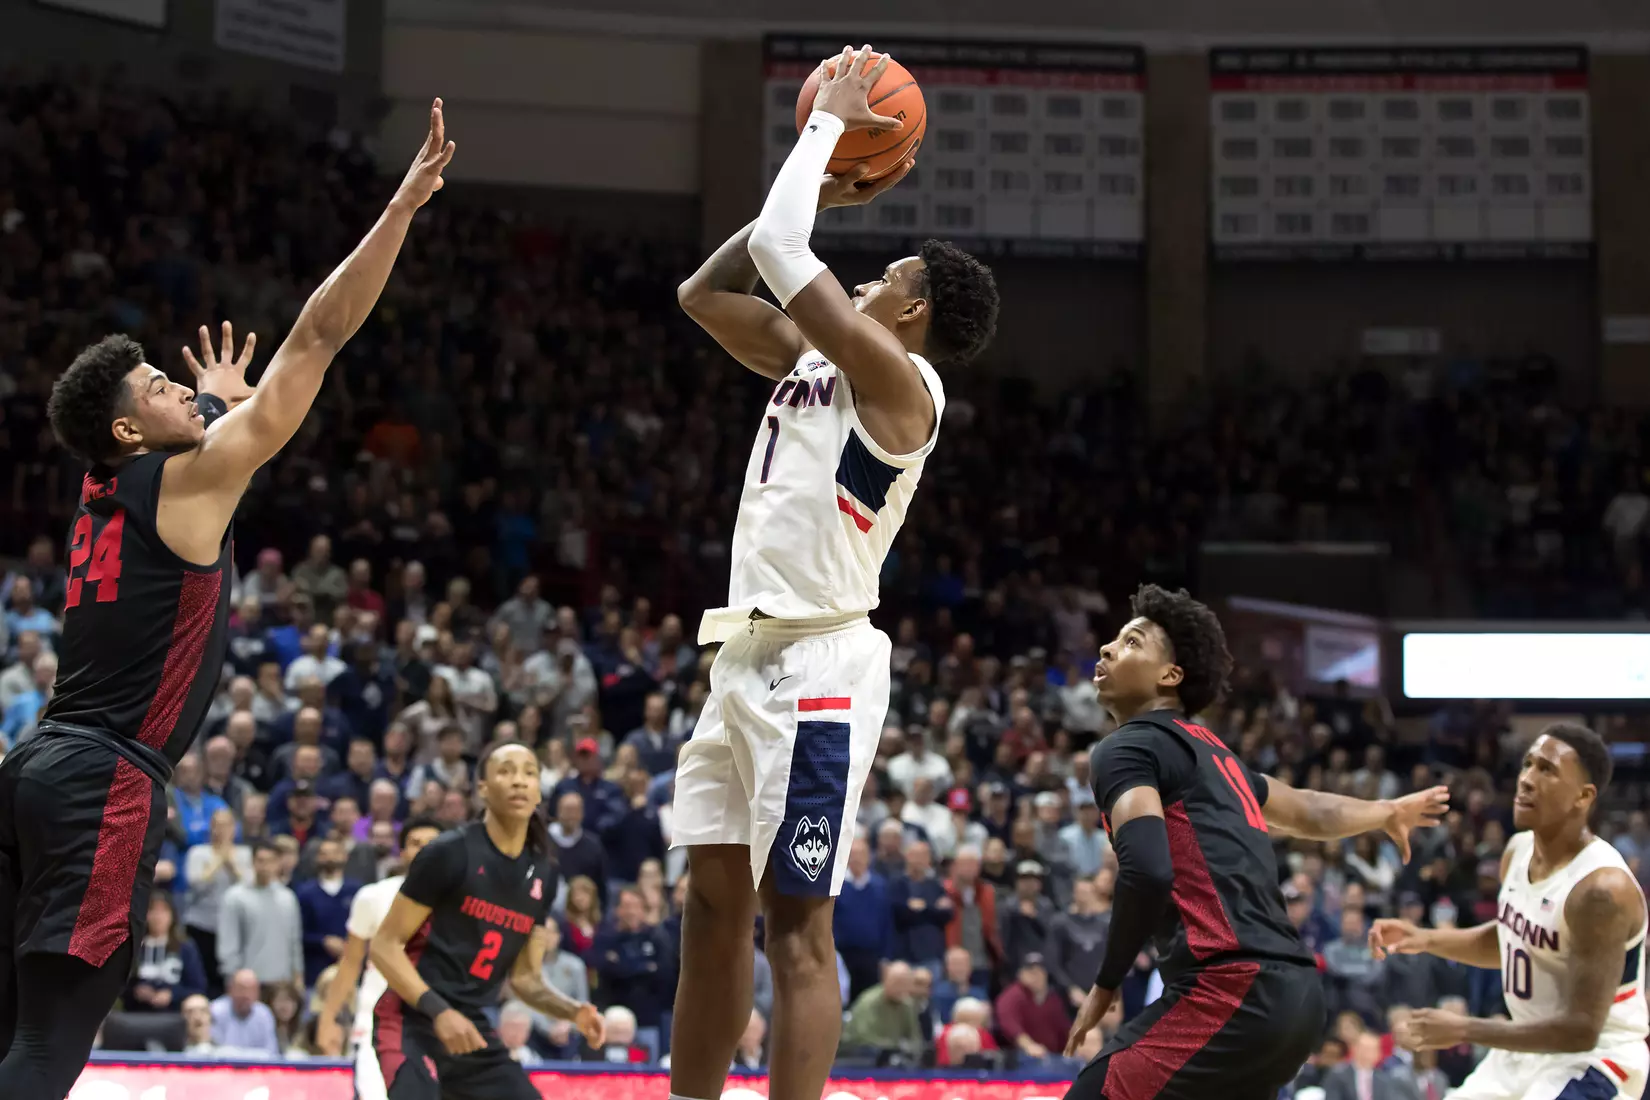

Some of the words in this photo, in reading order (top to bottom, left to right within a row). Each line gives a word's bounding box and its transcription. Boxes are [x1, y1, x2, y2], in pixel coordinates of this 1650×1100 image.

[760, 415, 780, 483] 1
[64, 509, 126, 611] 24
[460, 896, 535, 934] HOUSTON
[469, 930, 503, 980] 2
[1506, 943, 1531, 999] 10
